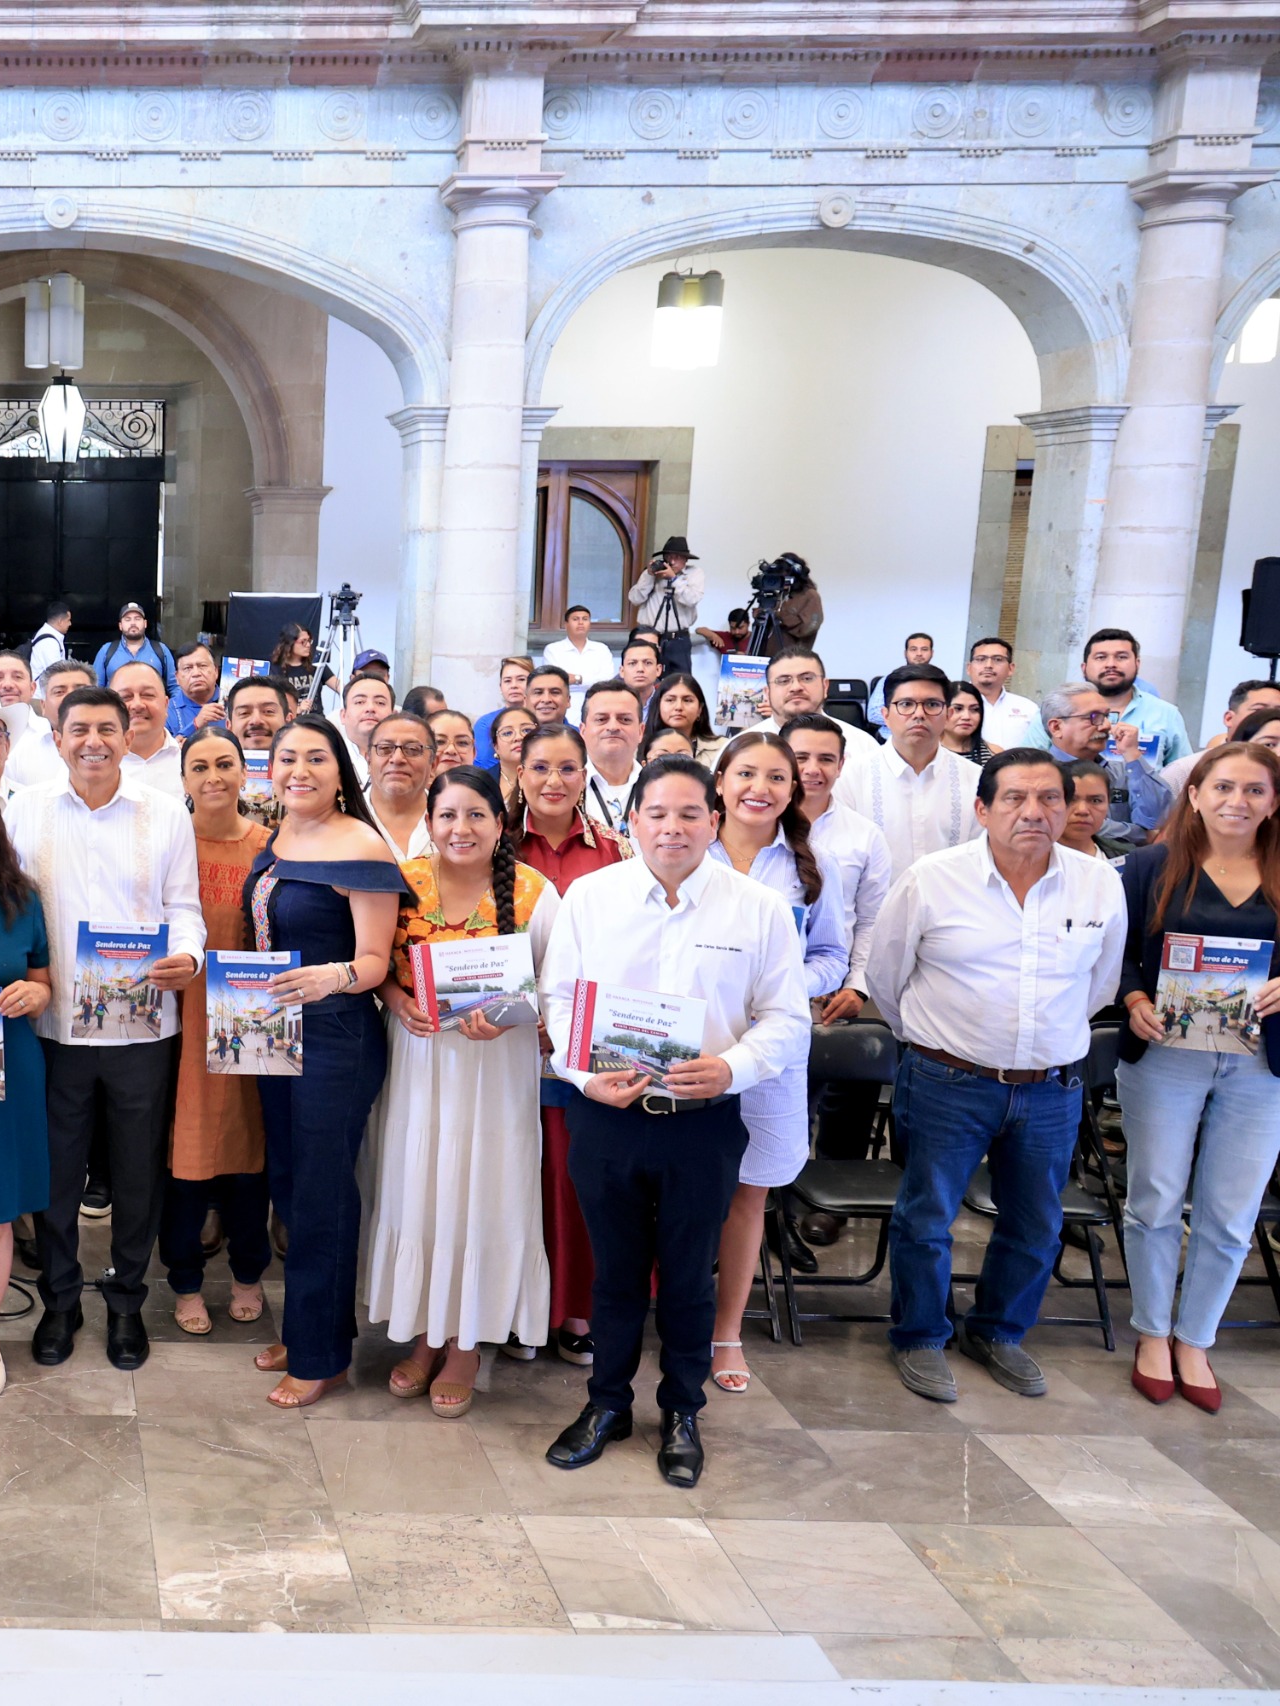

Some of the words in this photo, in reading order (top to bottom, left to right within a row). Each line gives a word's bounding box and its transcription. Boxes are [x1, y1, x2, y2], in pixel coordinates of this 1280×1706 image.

[95, 941, 126, 949] Senderos
[1232, 956, 1249, 965] Paz
[225, 971, 258, 979] Senderos
[259, 971, 268, 979] de
[645, 1016, 655, 1024] de
